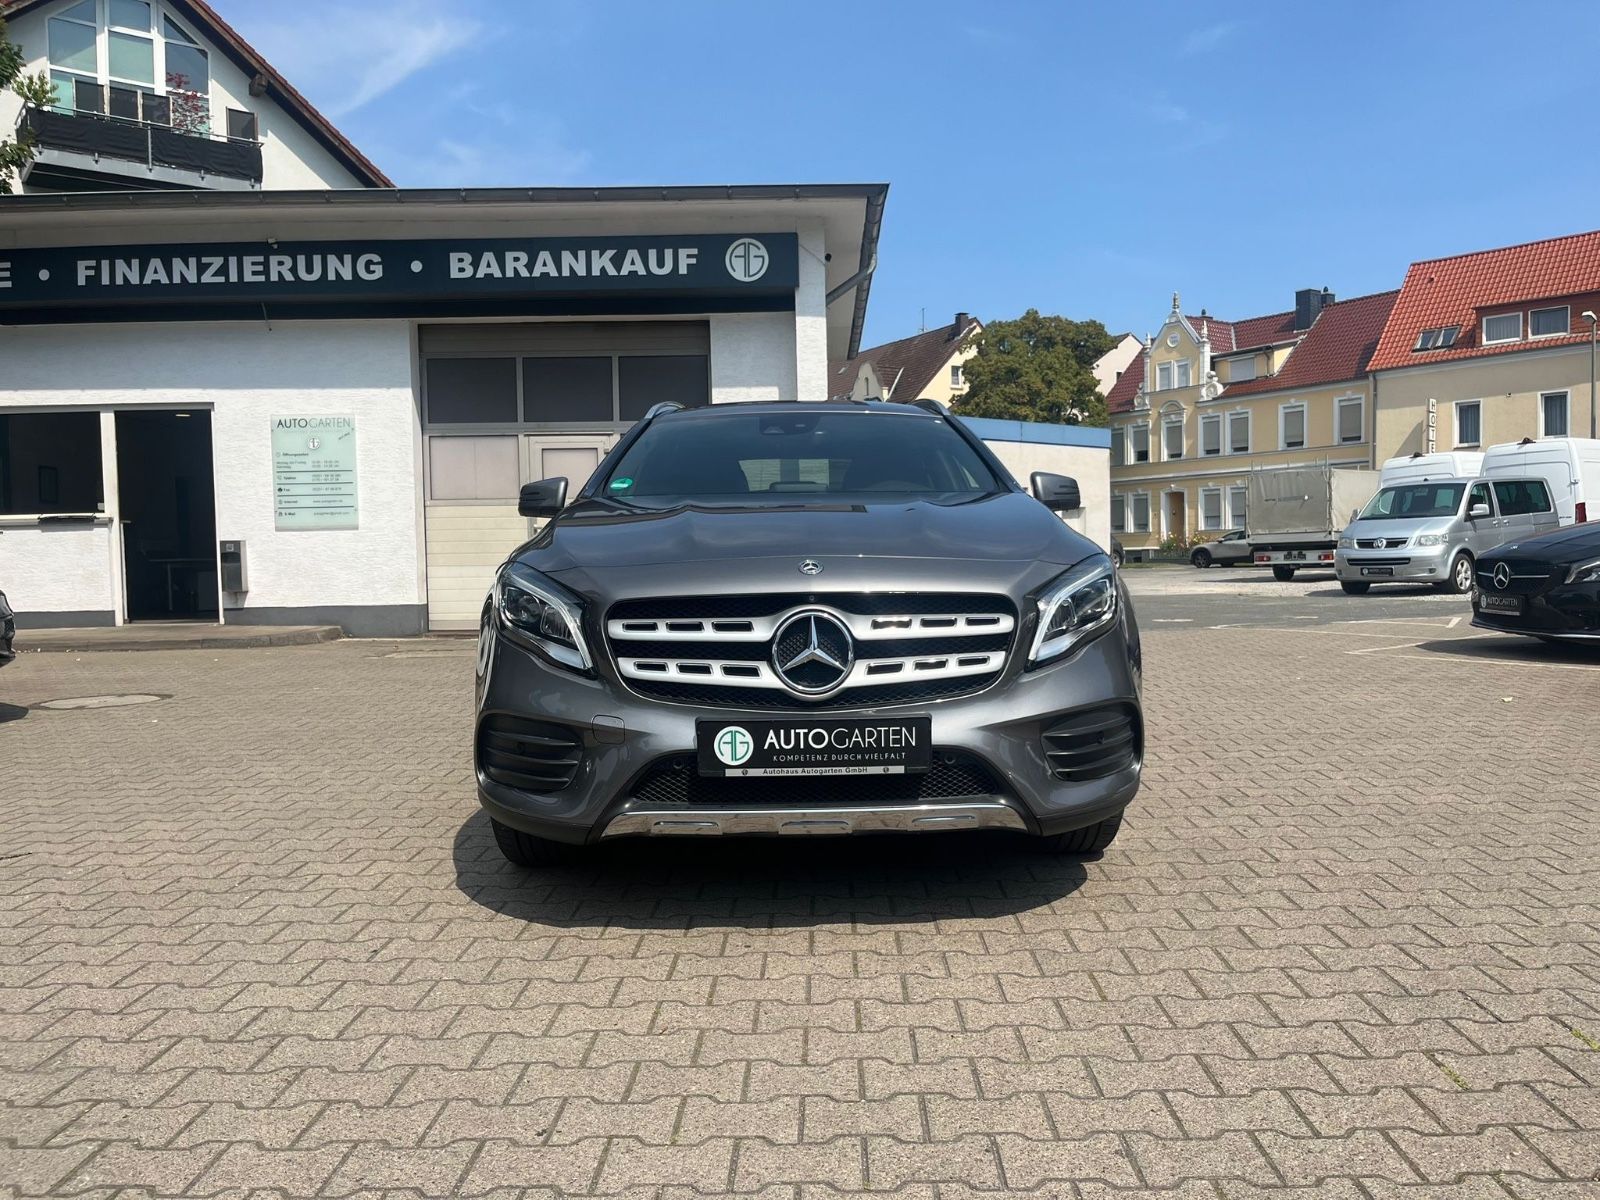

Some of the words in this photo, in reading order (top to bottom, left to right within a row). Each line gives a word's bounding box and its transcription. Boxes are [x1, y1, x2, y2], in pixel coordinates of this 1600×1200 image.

[77, 253, 384, 286] FINANZIERUNG
[449, 248, 699, 279] BARANKAUF
[277, 417, 351, 429] AUTOGARTEN
[763, 727, 916, 750] AUTOGARTEN
[773, 754, 828, 762] KOMPETENZ
[831, 753, 862, 761] DURCH
[865, 752, 906, 760] VIELFALT
[801, 767, 844, 775] Autogarten
[845, 766, 868, 774] GmbH
